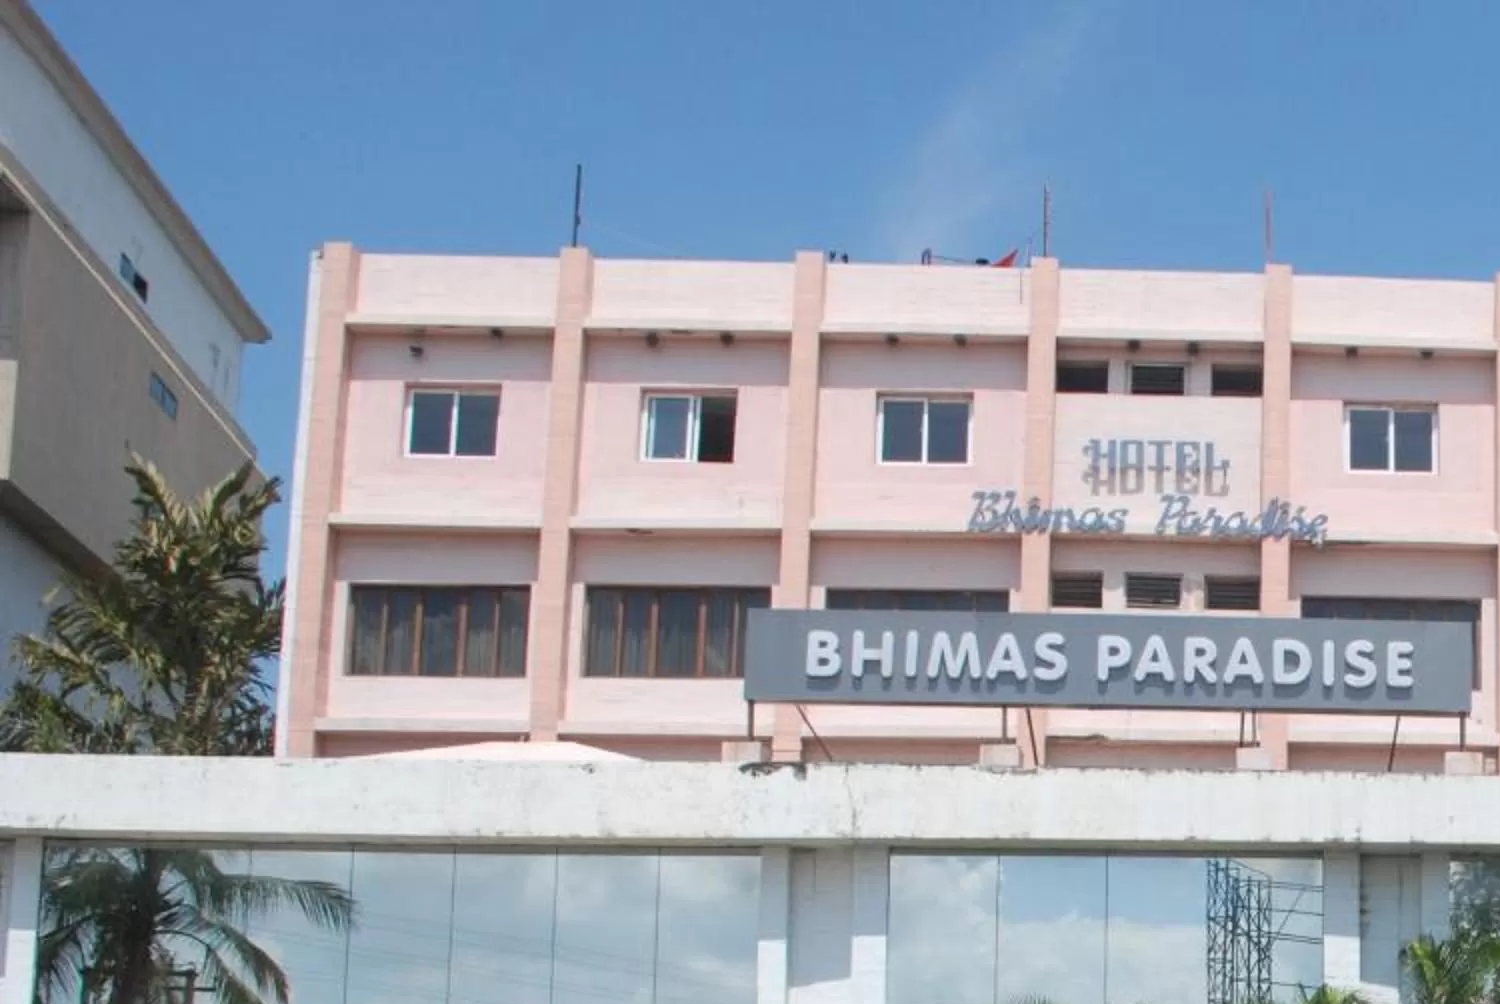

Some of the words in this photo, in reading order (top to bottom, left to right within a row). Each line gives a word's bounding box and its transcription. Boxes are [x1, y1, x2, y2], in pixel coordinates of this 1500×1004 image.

[1083, 438, 1231, 478] HOTEL
[967, 491, 1129, 535] Bhimas
[1154, 494, 1328, 546] Paradise
[805, 629, 1068, 681] BHIMAS
[1097, 634, 1414, 688] PARADISE
